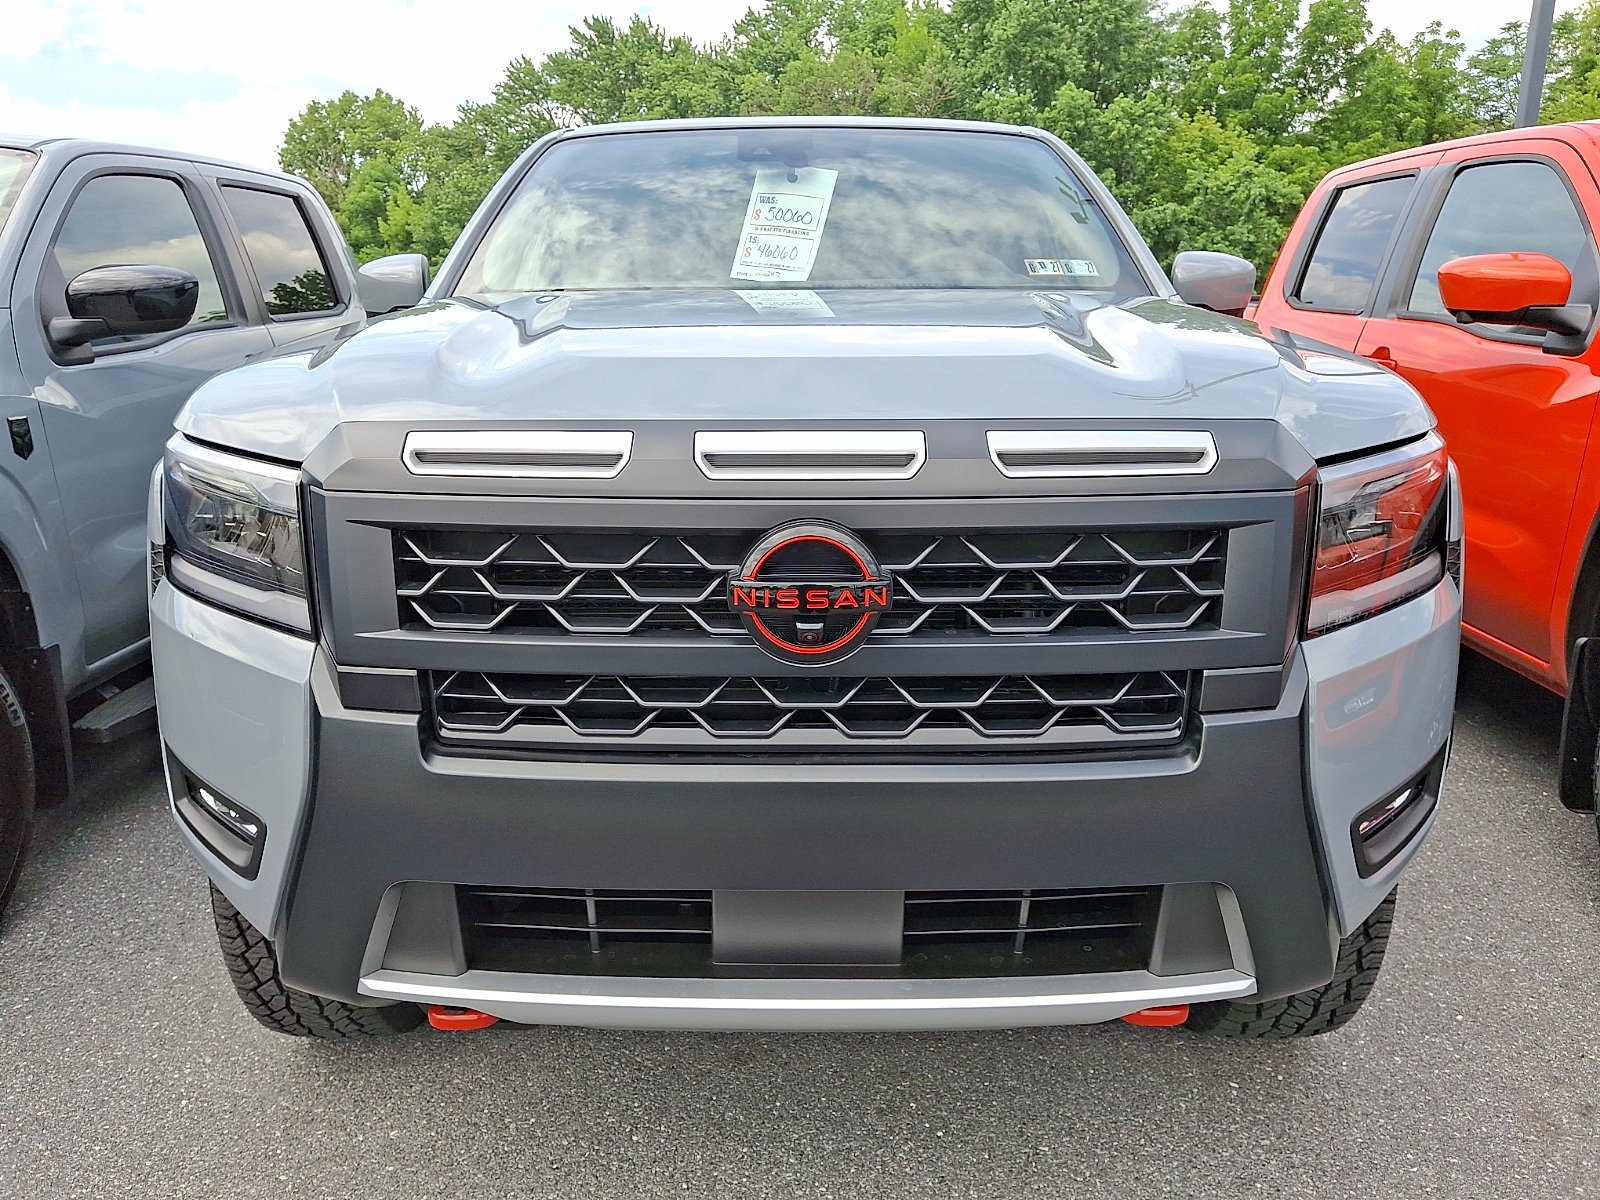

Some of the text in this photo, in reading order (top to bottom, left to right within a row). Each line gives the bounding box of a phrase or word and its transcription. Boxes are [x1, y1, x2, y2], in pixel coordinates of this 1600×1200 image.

[759, 195, 778, 204] WAS:
[754, 206, 813, 225] $ 50060
[748, 235, 760, 244] IS:
[744, 244, 799, 260] $ 46060
[733, 587, 888, 609] NISSAN
